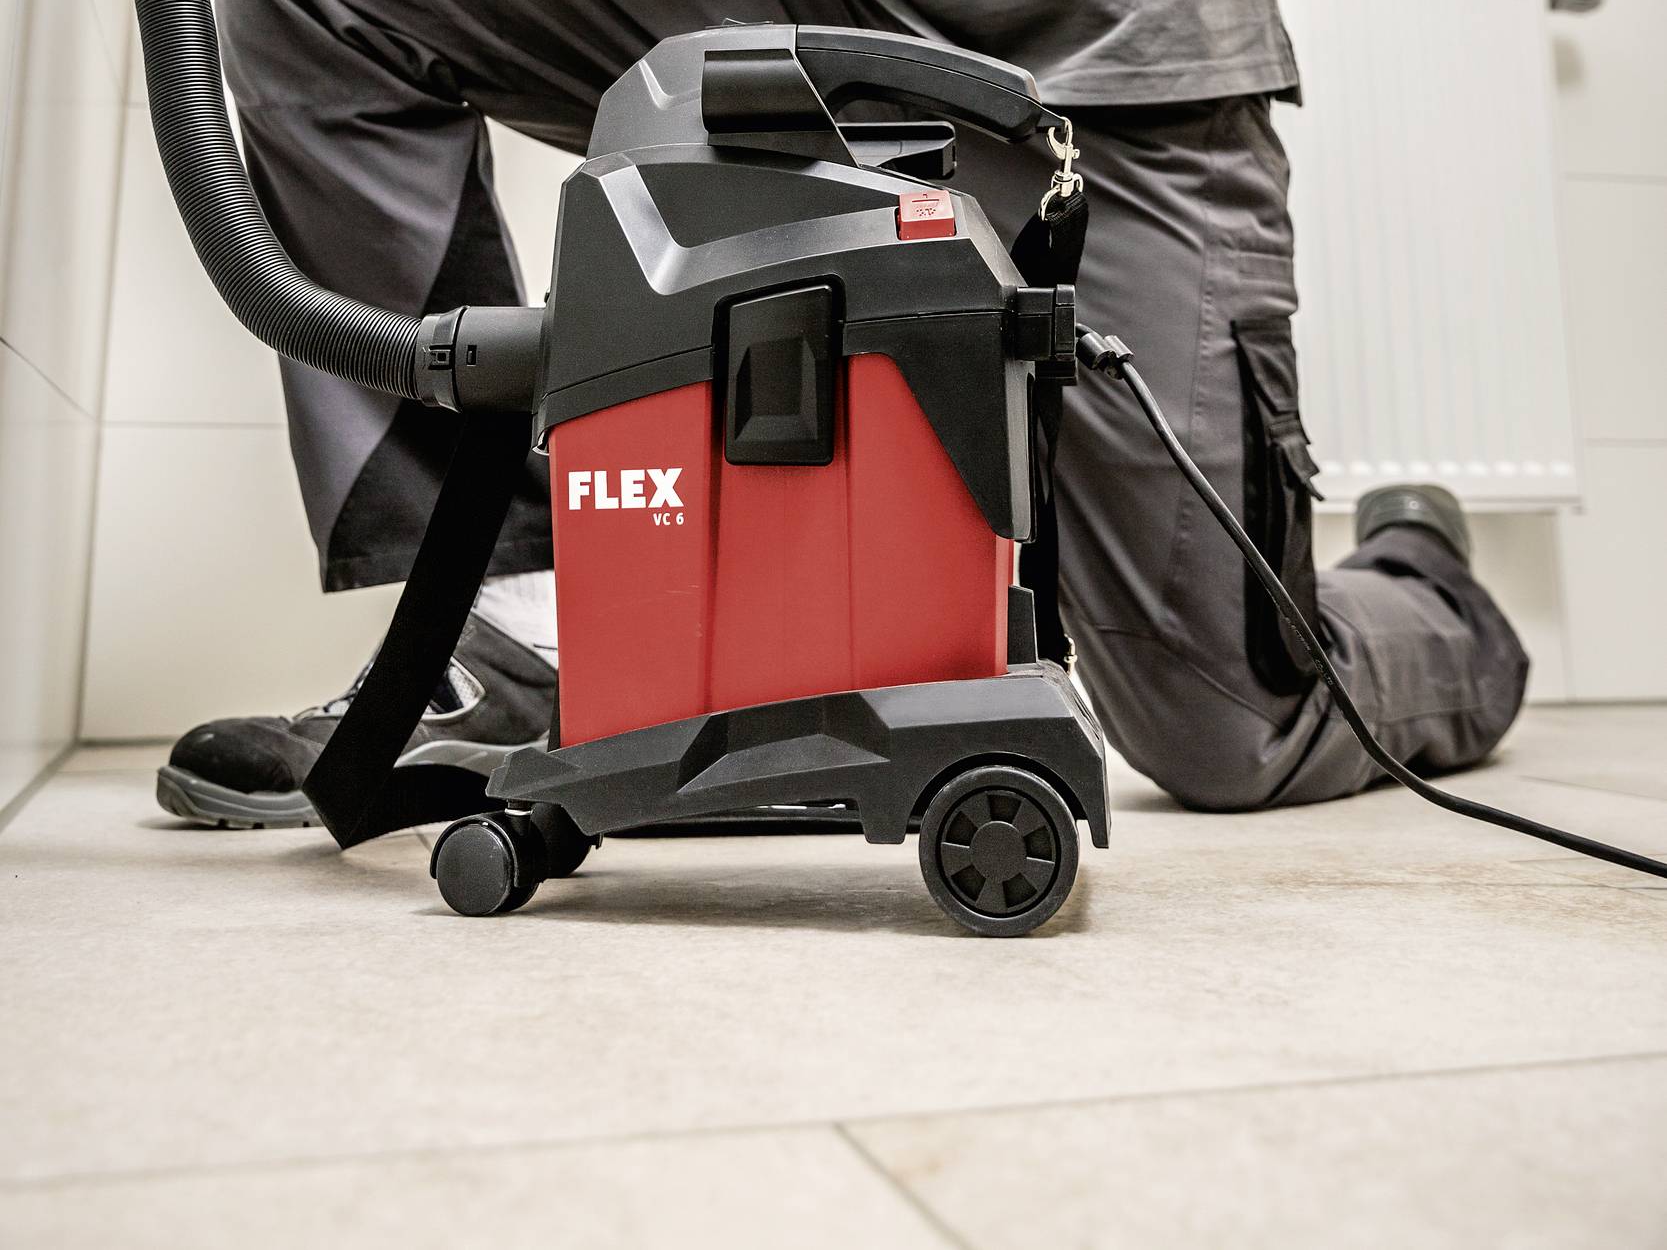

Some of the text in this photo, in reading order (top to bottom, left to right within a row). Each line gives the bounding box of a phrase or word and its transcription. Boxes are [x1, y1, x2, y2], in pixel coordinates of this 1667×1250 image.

[568, 467, 685, 510] FLEX
[653, 512, 684, 526] VC 6
